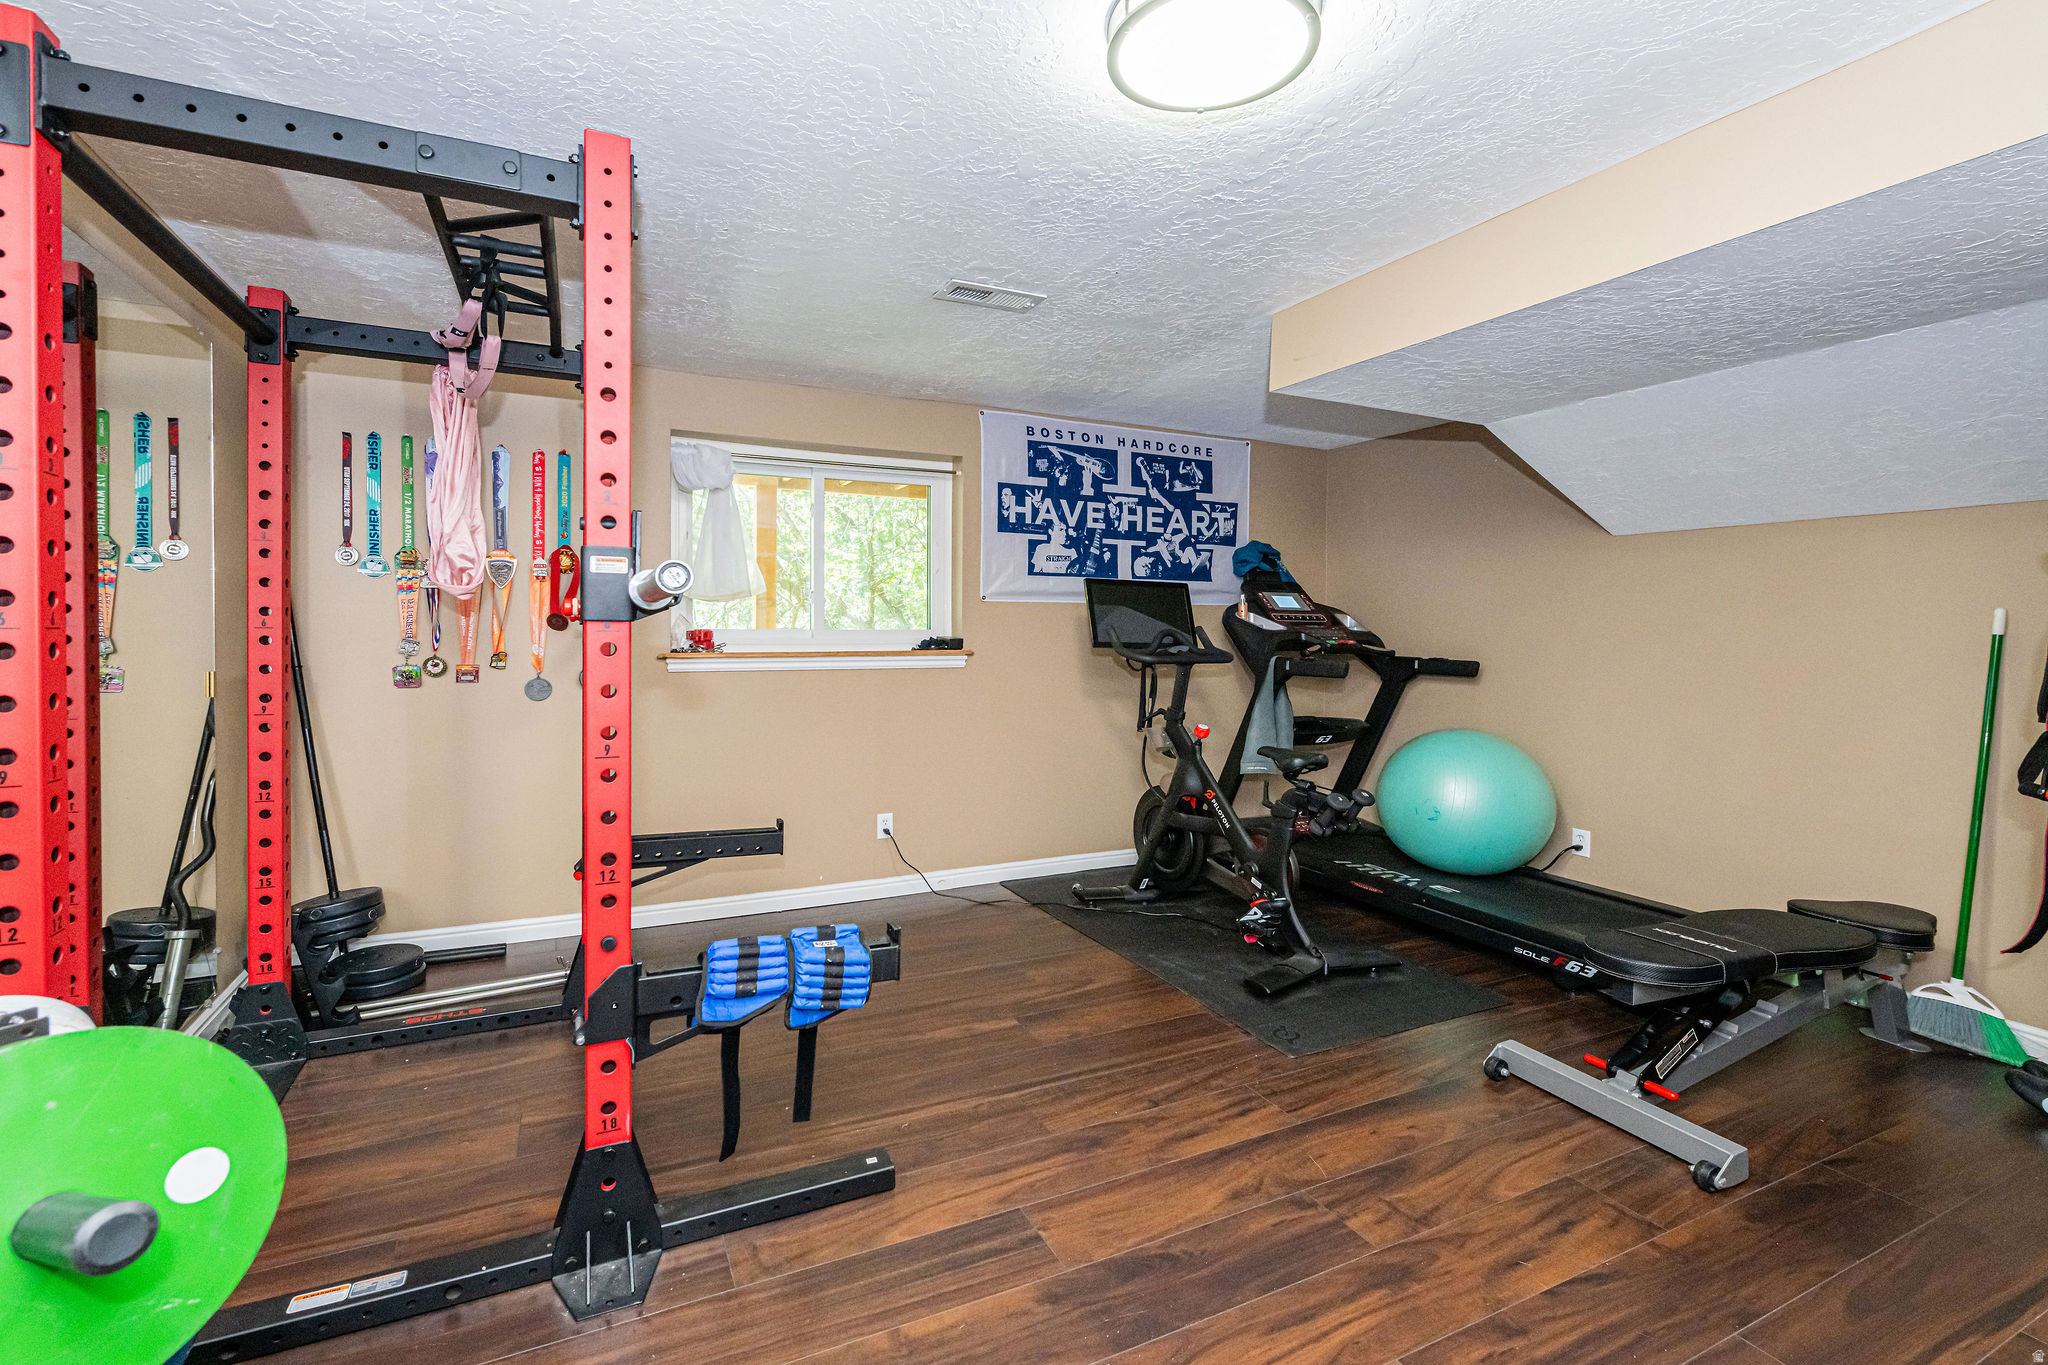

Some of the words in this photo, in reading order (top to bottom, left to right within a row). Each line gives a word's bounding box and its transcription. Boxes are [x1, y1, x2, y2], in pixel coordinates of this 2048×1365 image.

[1026, 426, 1104, 445] BOSTON
[1117, 437, 1213, 457] HARDCORE
[404, 493, 412, 505] 1/2
[603, 490, 610, 501] 3
[1009, 495, 1106, 529] HAVE
[1121, 502, 1231, 537] HEART
[404, 507, 413, 547] MARATHO
[604, 744, 611, 756] 9
[258, 792, 271, 801] 12
[1211, 798, 1231, 829] PELOTON
[258, 877, 272, 887] 15
[600, 869, 616, 882] 12
[259, 964, 273, 973] 18
[1513, 946, 1551, 964] SOLE
[1553, 956, 1598, 978] F63
[405, 1007, 483, 1025] ETHOS
[601, 1117, 618, 1131] 18
